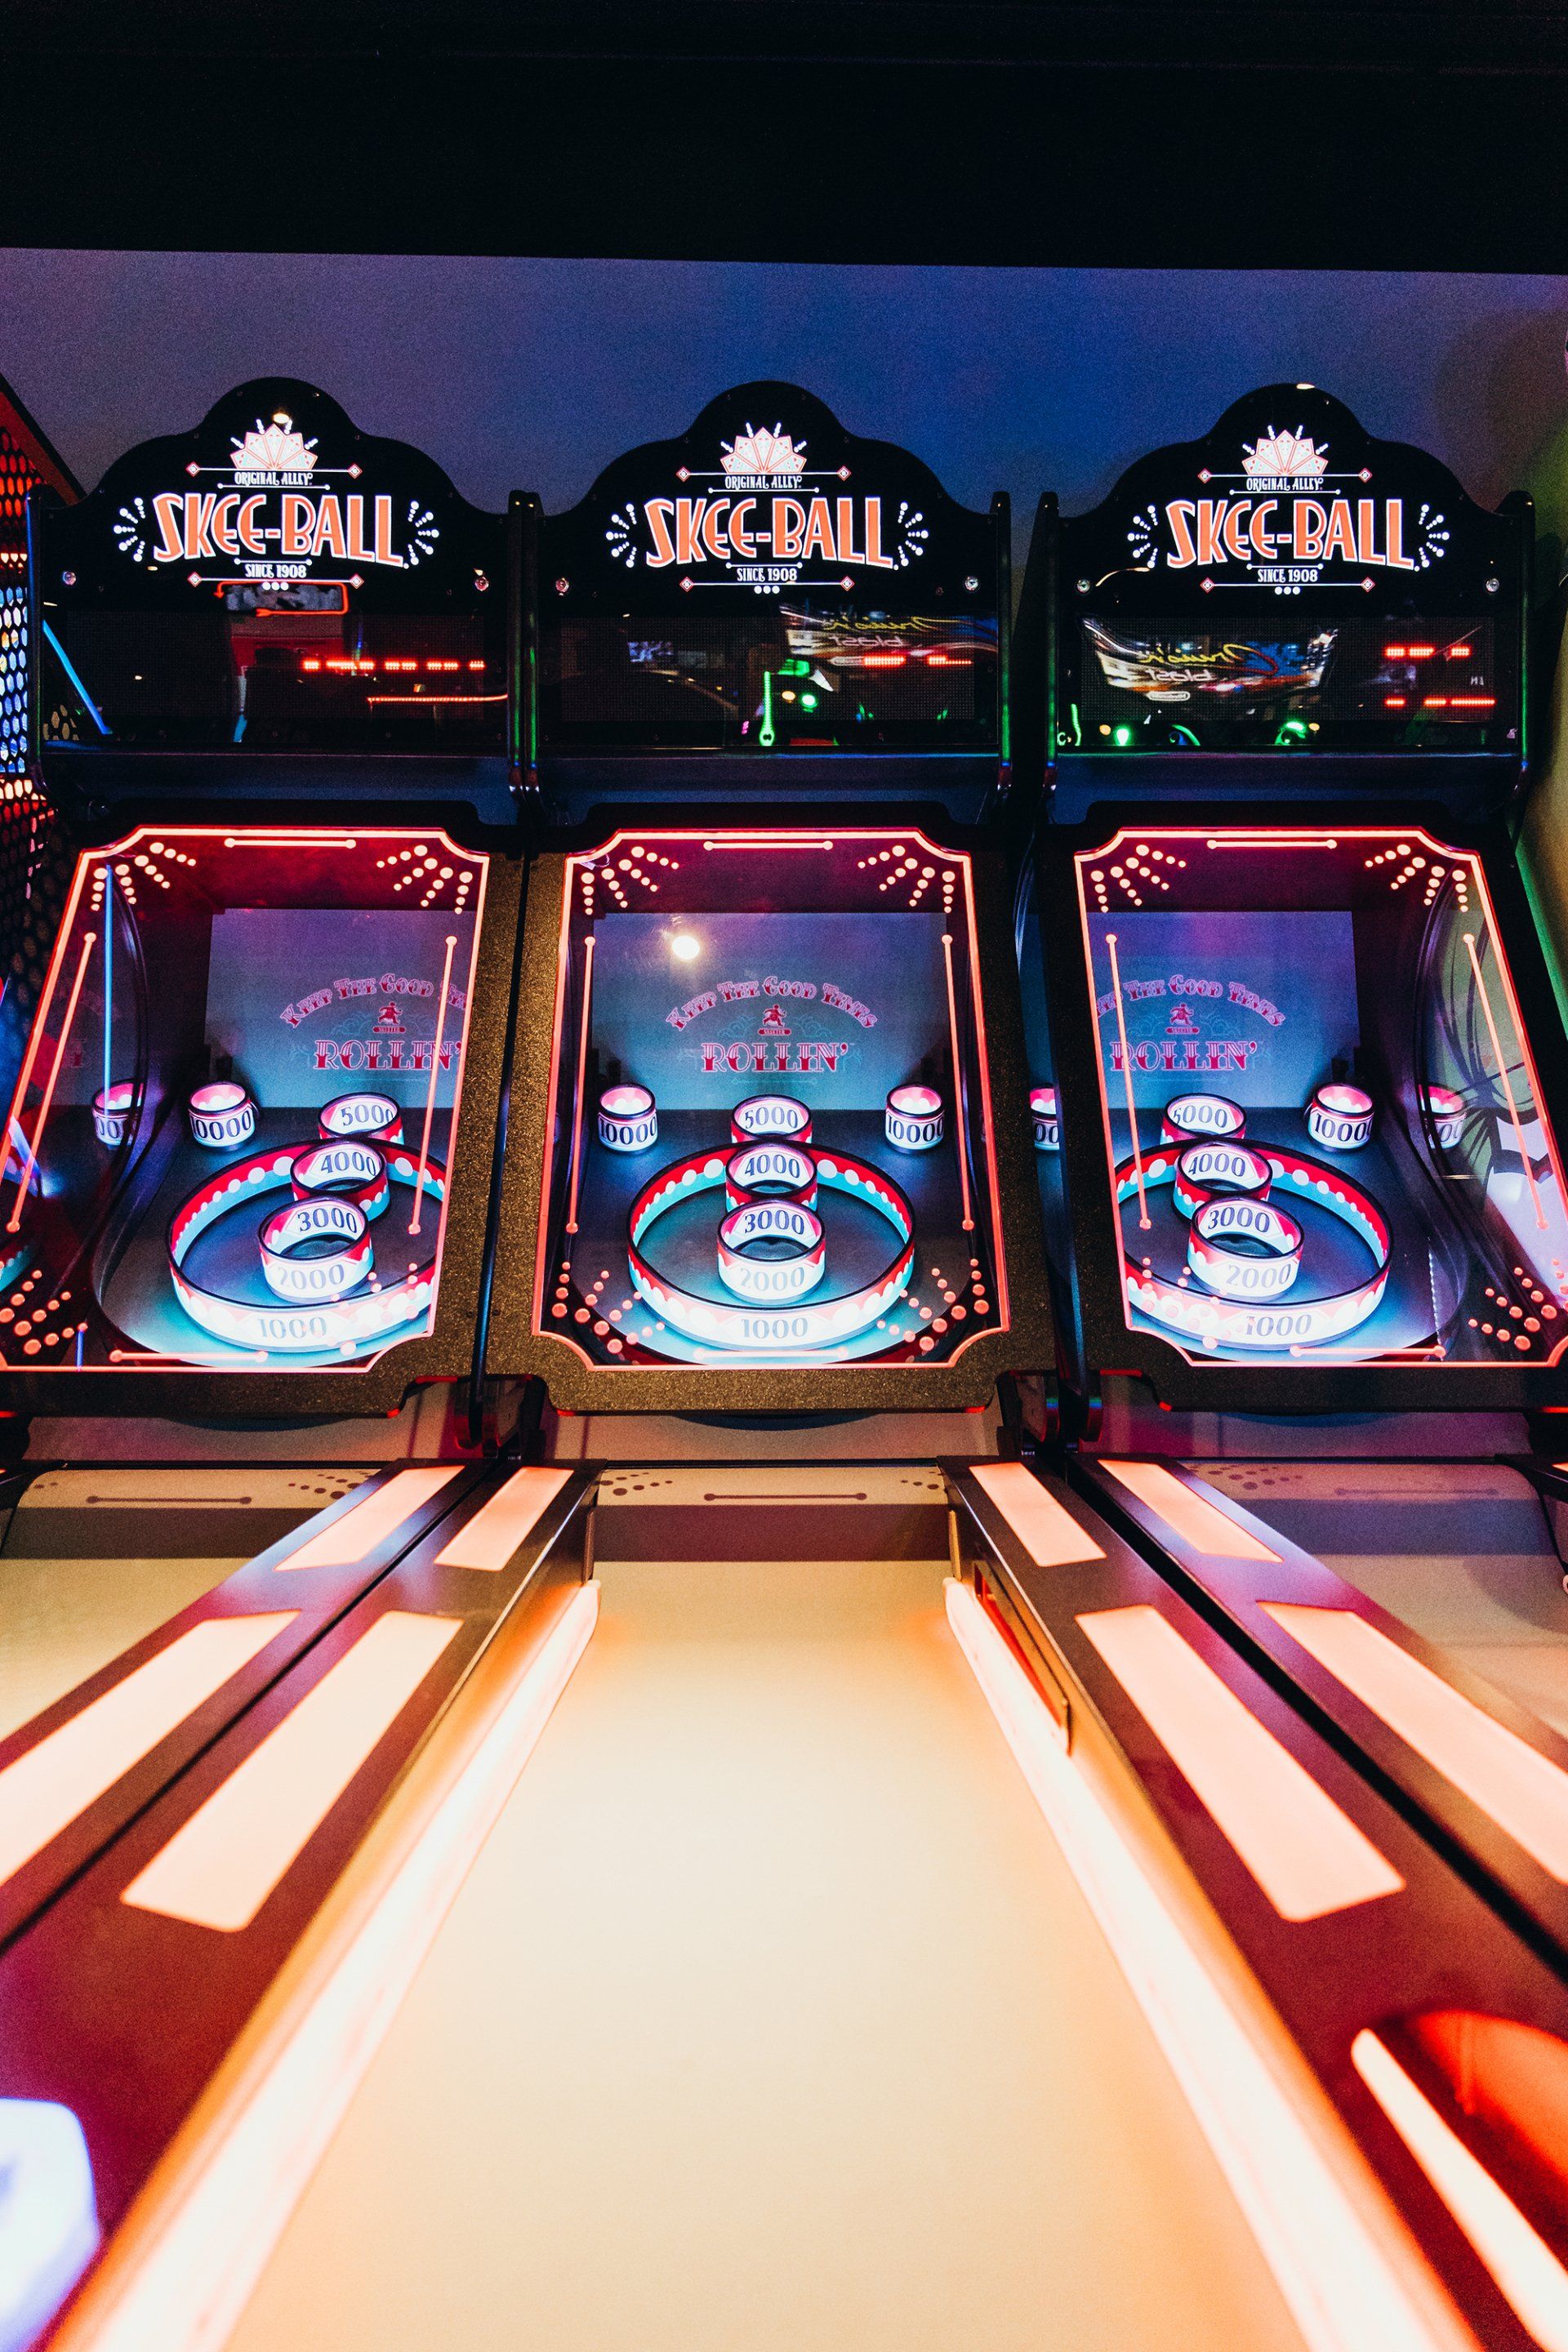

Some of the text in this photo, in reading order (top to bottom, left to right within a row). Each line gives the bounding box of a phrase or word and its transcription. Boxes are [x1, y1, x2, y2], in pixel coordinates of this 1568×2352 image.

[234, 471, 280, 486] ORIGINAL
[724, 475, 769, 490] ORIGINAL
[1246, 477, 1290, 492] ORIGINAL
[153, 492, 405, 568] SKEE-BALL
[644, 497, 894, 568] SKEE-BALL
[1165, 498, 1415, 571] SKEE-BALL
[244, 564, 307, 578] SINCE 1908
[736, 568, 797, 581] SINCE 1908
[1257, 569, 1318, 583] SINCE 1908
[700, 1041, 849, 1073] ROLLIN'
[1109, 1040, 1258, 1071] ROLLIN'
[340, 1104, 394, 1127] 5000
[744, 1106, 798, 1129] 5000
[1173, 1105, 1228, 1129] 5000
[599, 1116, 657, 1145] 10000
[888, 1114, 944, 1143] 10000
[320, 1151, 376, 1177] 4000
[744, 1154, 800, 1178] 4000
[1187, 1152, 1246, 1178] 4000
[297, 1207, 358, 1234] 3000
[744, 1209, 805, 1236] 3000
[1208, 1206, 1271, 1233] 3000
[278, 1264, 345, 1290] 2000
[739, 1267, 806, 1292] 2000
[1225, 1263, 1292, 1289] 2000
[257, 1316, 327, 1339] 1000
[741, 1317, 809, 1339] 1000
[1245, 1313, 1312, 1337] 1000
